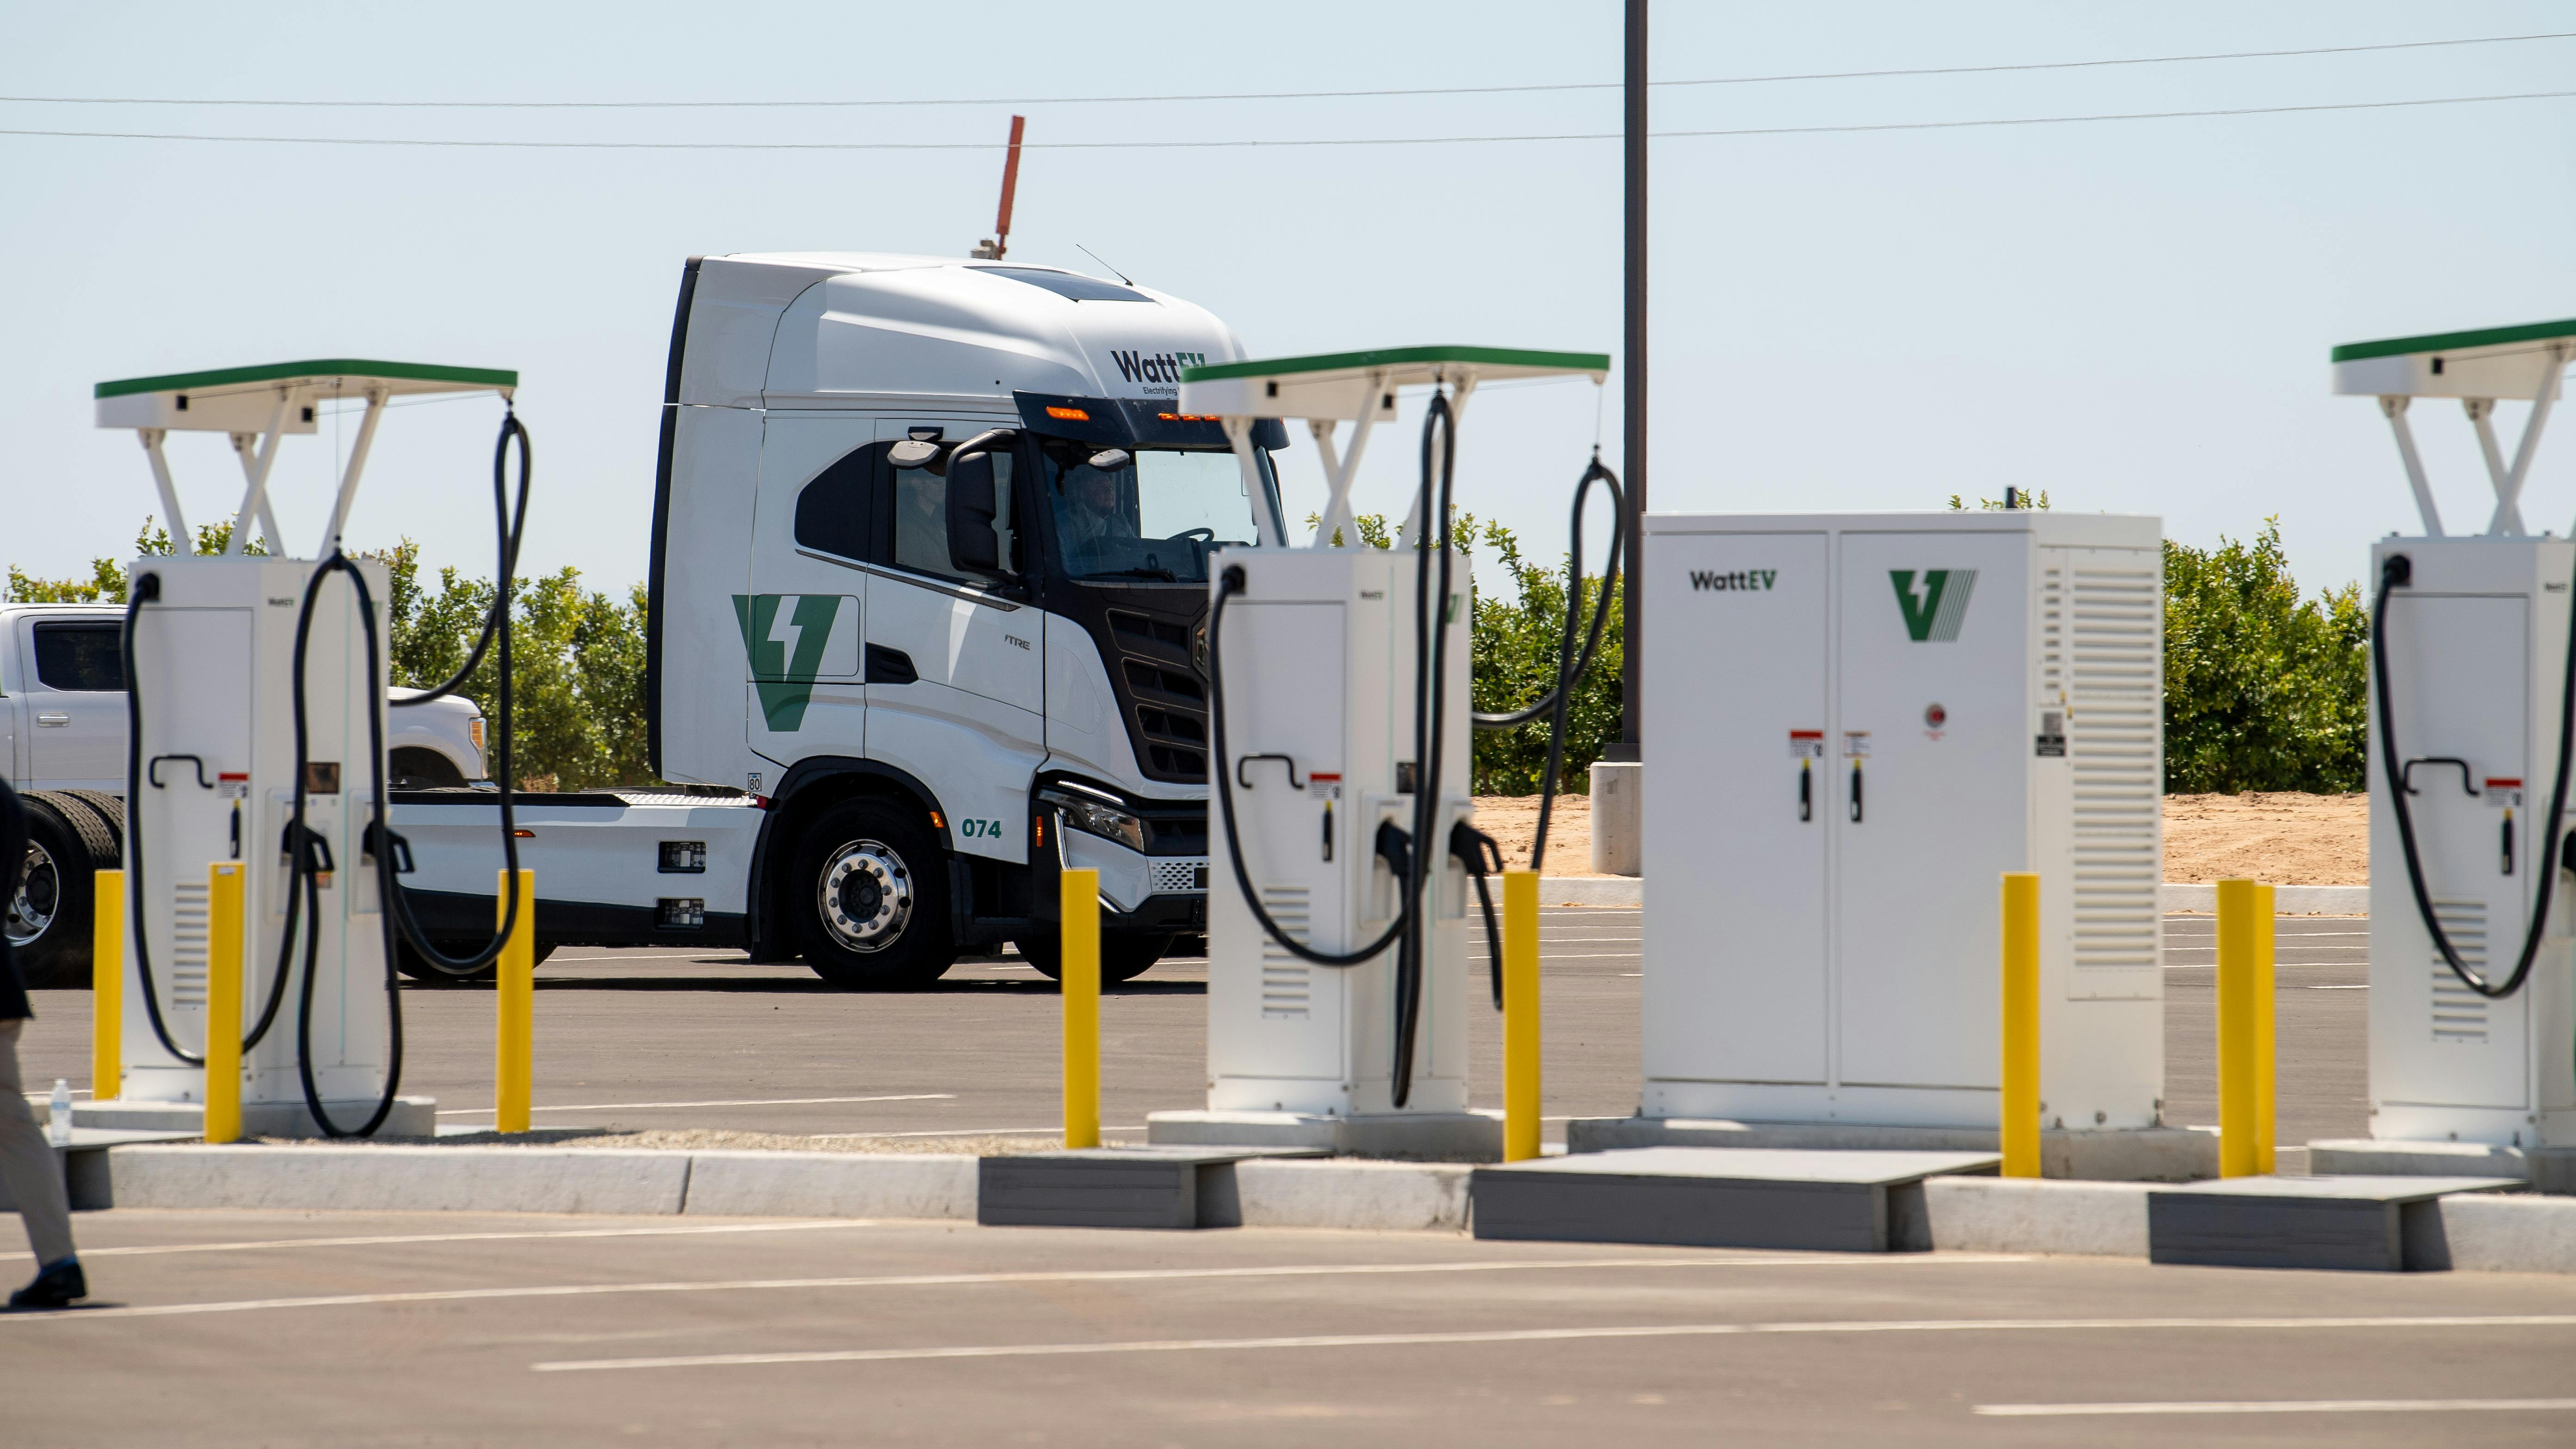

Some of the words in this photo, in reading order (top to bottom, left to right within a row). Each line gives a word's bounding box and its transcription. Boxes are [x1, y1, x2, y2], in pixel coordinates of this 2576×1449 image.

[1142, 386, 1177, 396] Electrifying
[1690, 570, 1777, 592] WattEV
[749, 778, 760, 790] 80
[962, 818, 1002, 838] 074
